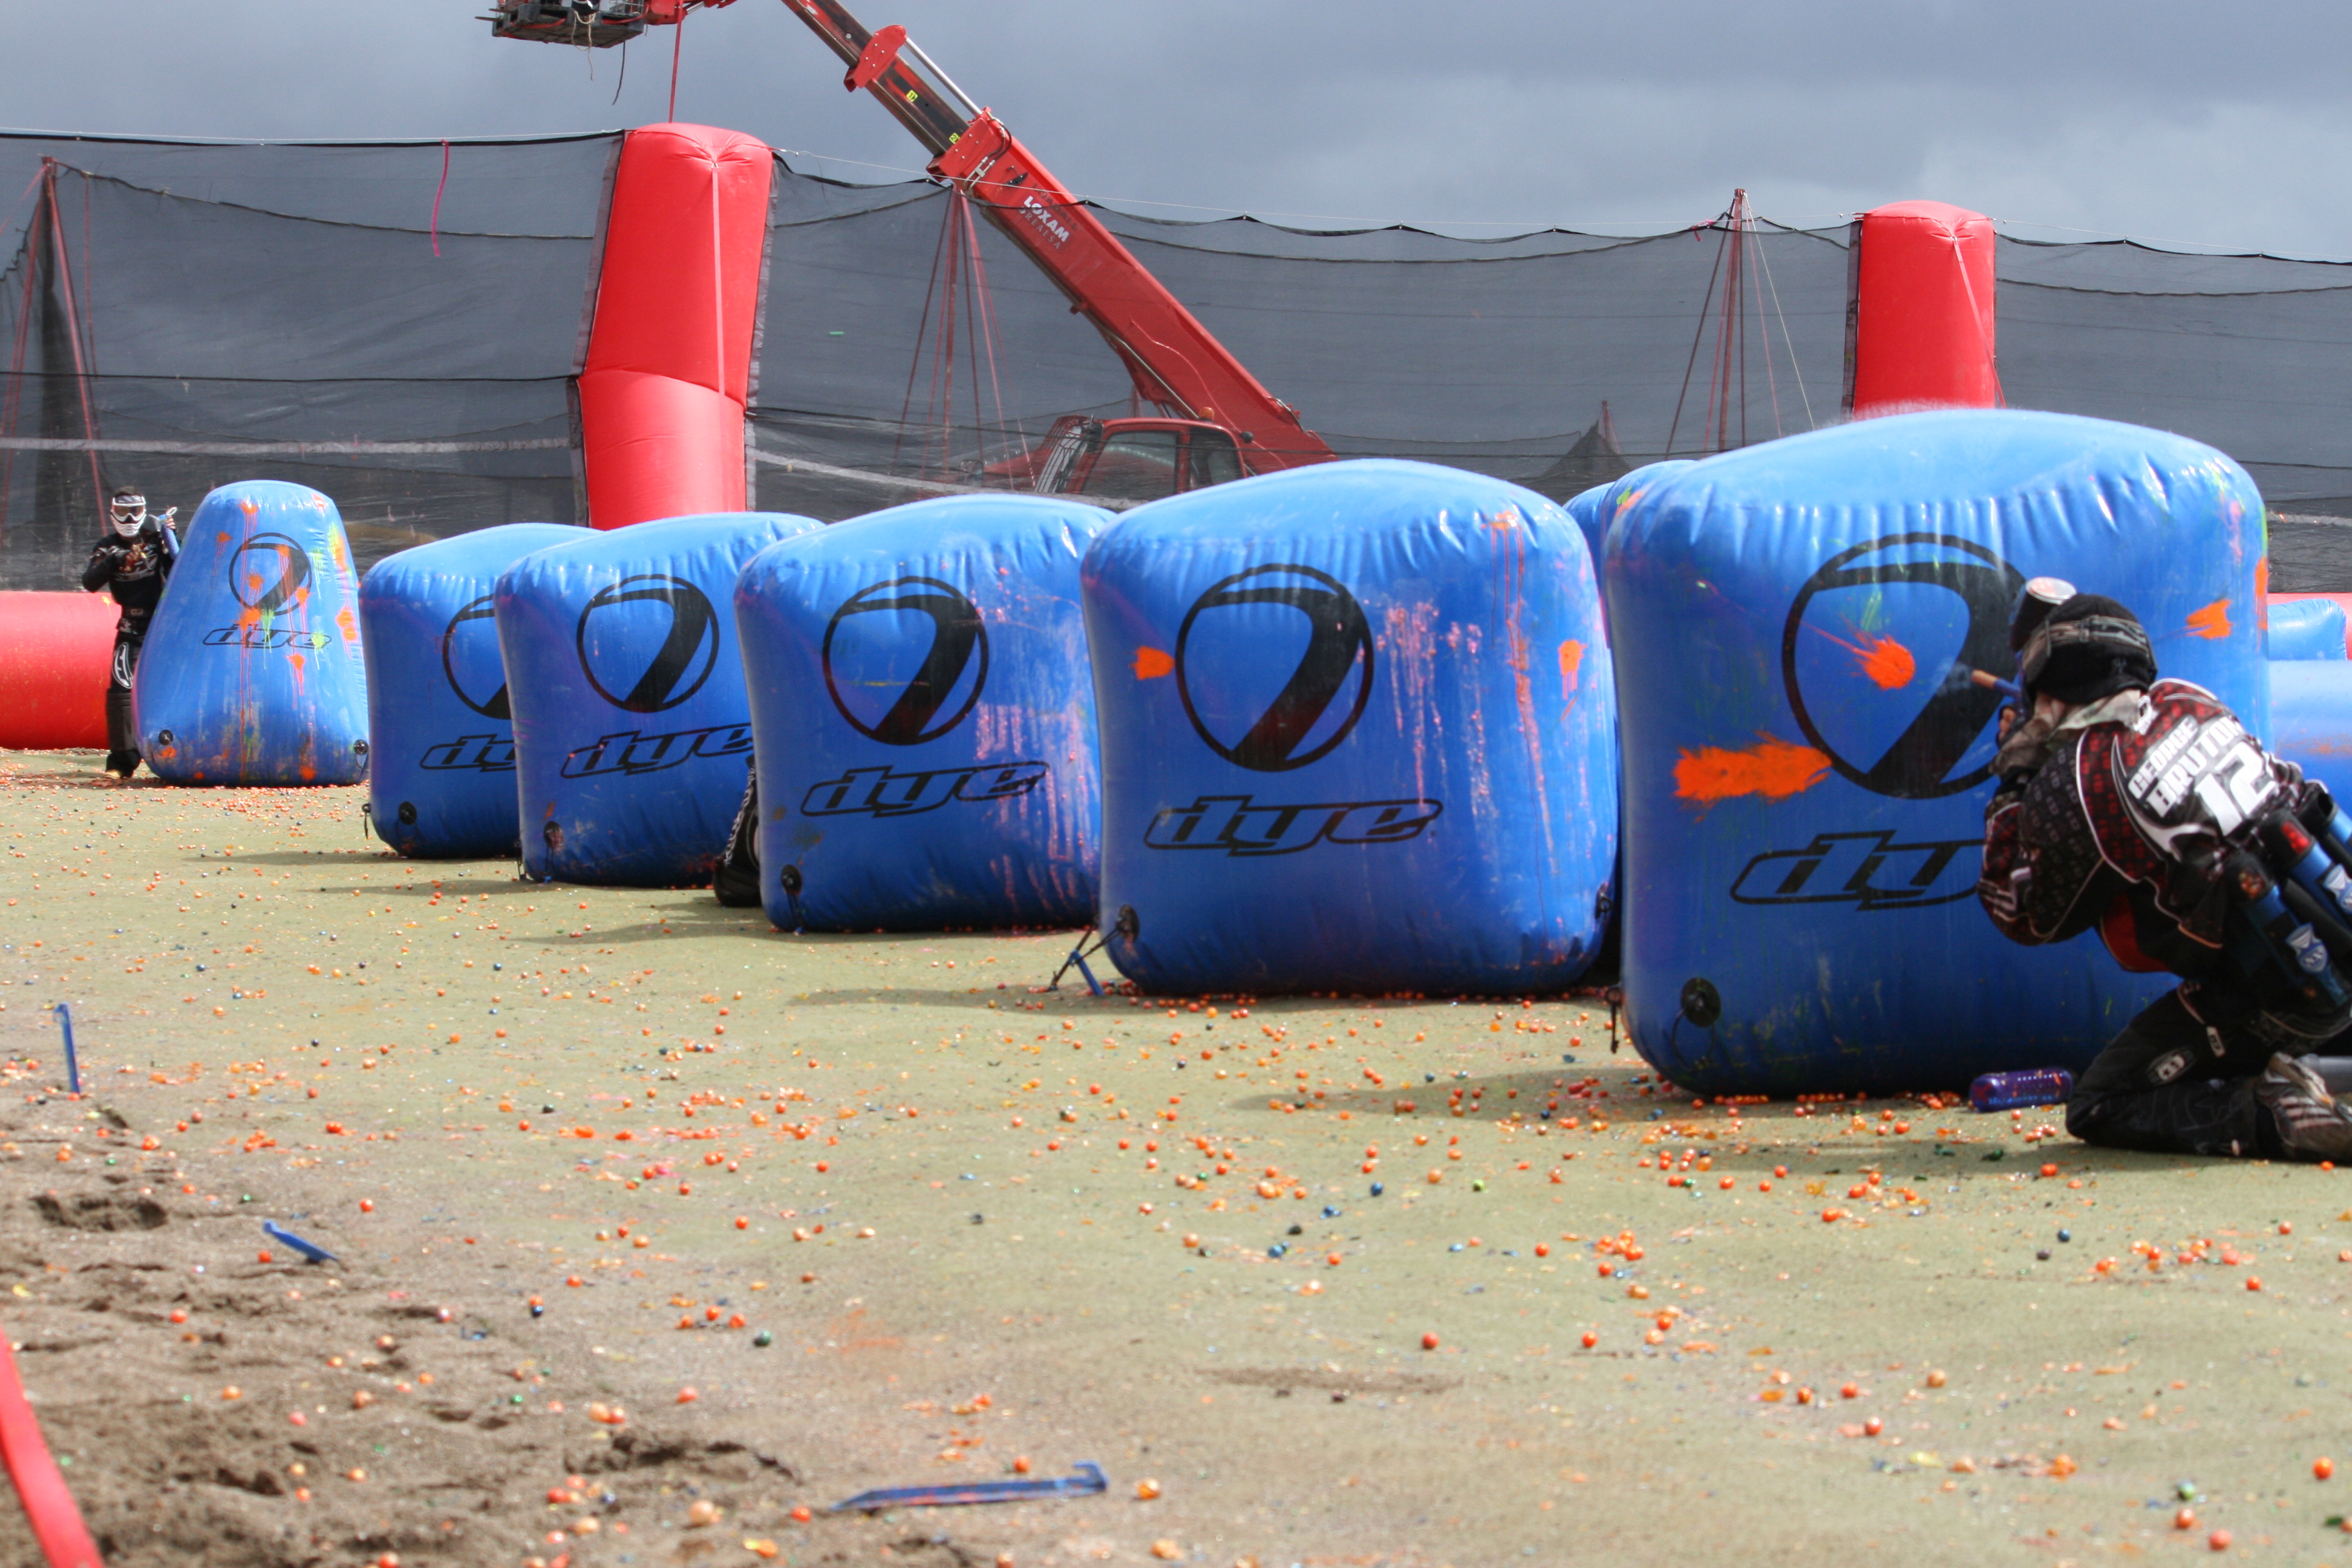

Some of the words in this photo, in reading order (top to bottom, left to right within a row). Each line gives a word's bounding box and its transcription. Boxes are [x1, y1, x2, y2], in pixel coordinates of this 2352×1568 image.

[1024, 195, 1070, 243] LOXAM
[800, 760, 1050, 818] dye
[2128, 716, 2199, 800] GEORGE
[2146, 716, 2246, 817] BRUTON
[2194, 740, 2279, 837] 12
[1143, 795, 1443, 858] dye
